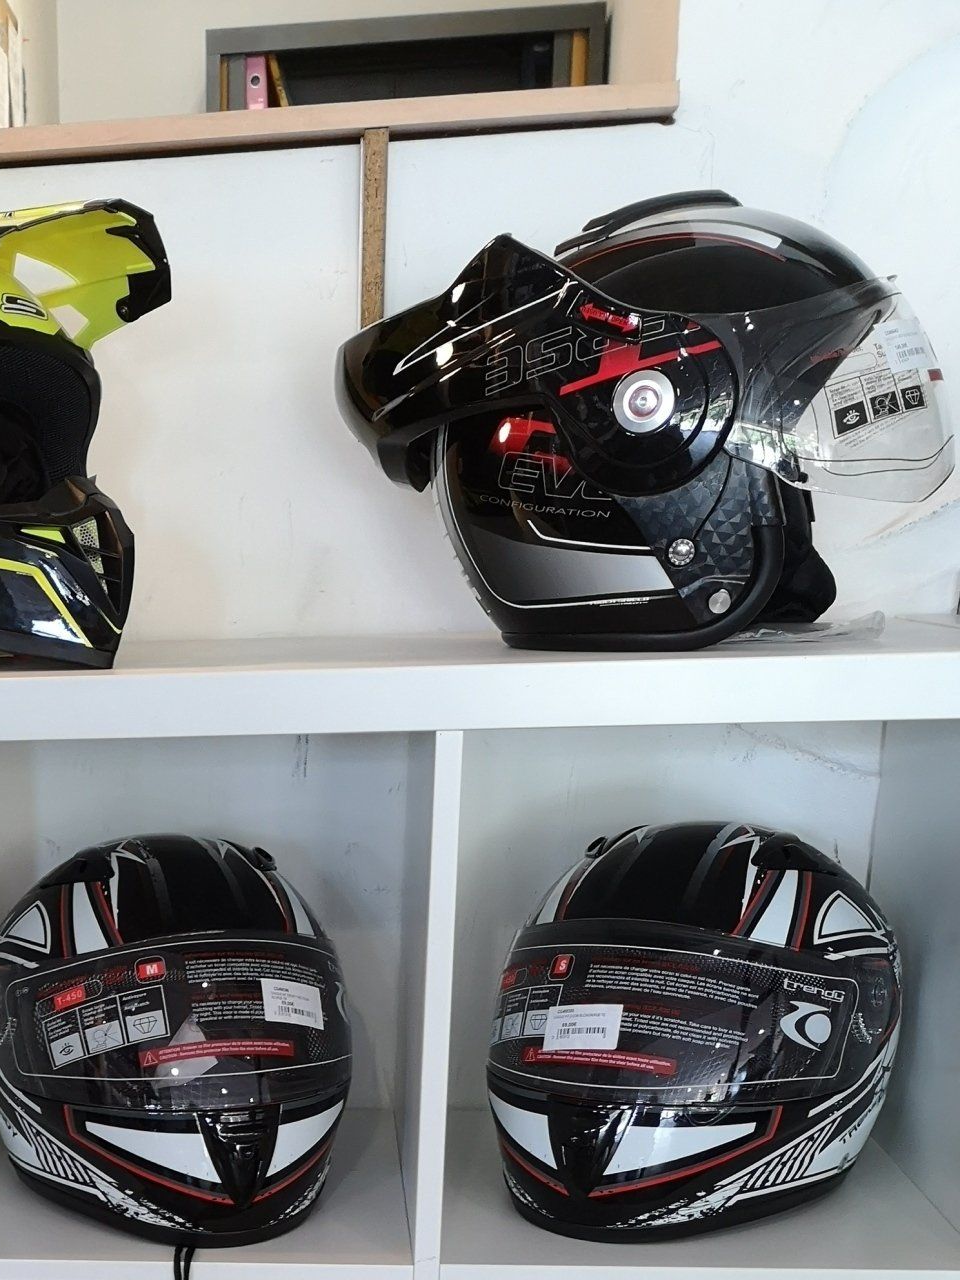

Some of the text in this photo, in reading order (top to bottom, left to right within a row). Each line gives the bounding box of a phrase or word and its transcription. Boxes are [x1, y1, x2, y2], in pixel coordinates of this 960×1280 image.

[479, 494, 611, 519] CONFIGURATION
[146, 964, 157, 974] M
[559, 960, 566, 970] S
[57, 989, 83, 1006] T-450
[783, 977, 846, 1003] trendy
